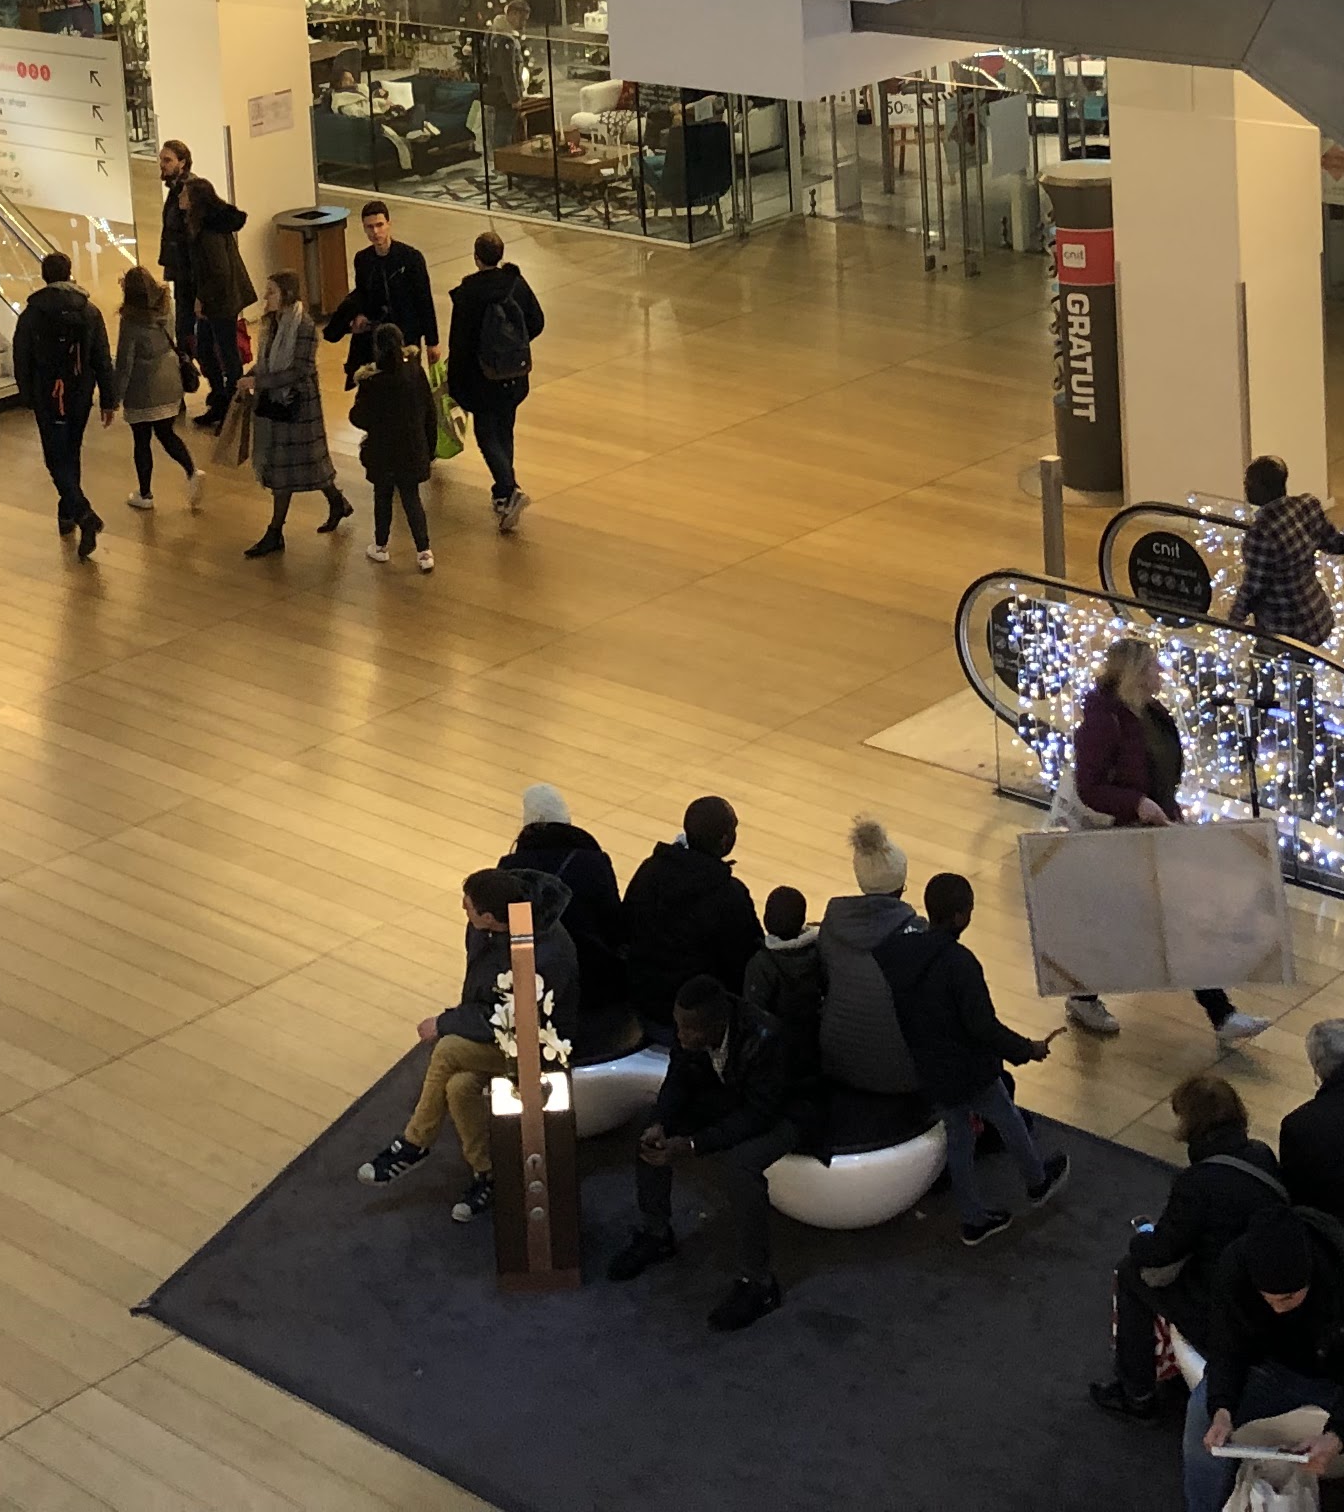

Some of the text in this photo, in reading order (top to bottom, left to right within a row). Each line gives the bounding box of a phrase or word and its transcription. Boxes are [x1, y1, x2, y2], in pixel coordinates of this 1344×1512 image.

[1063, 249, 1084, 260] cnit
[1066, 292, 1096, 423] GRATUIT
[1152, 541, 1180, 559] cnit
